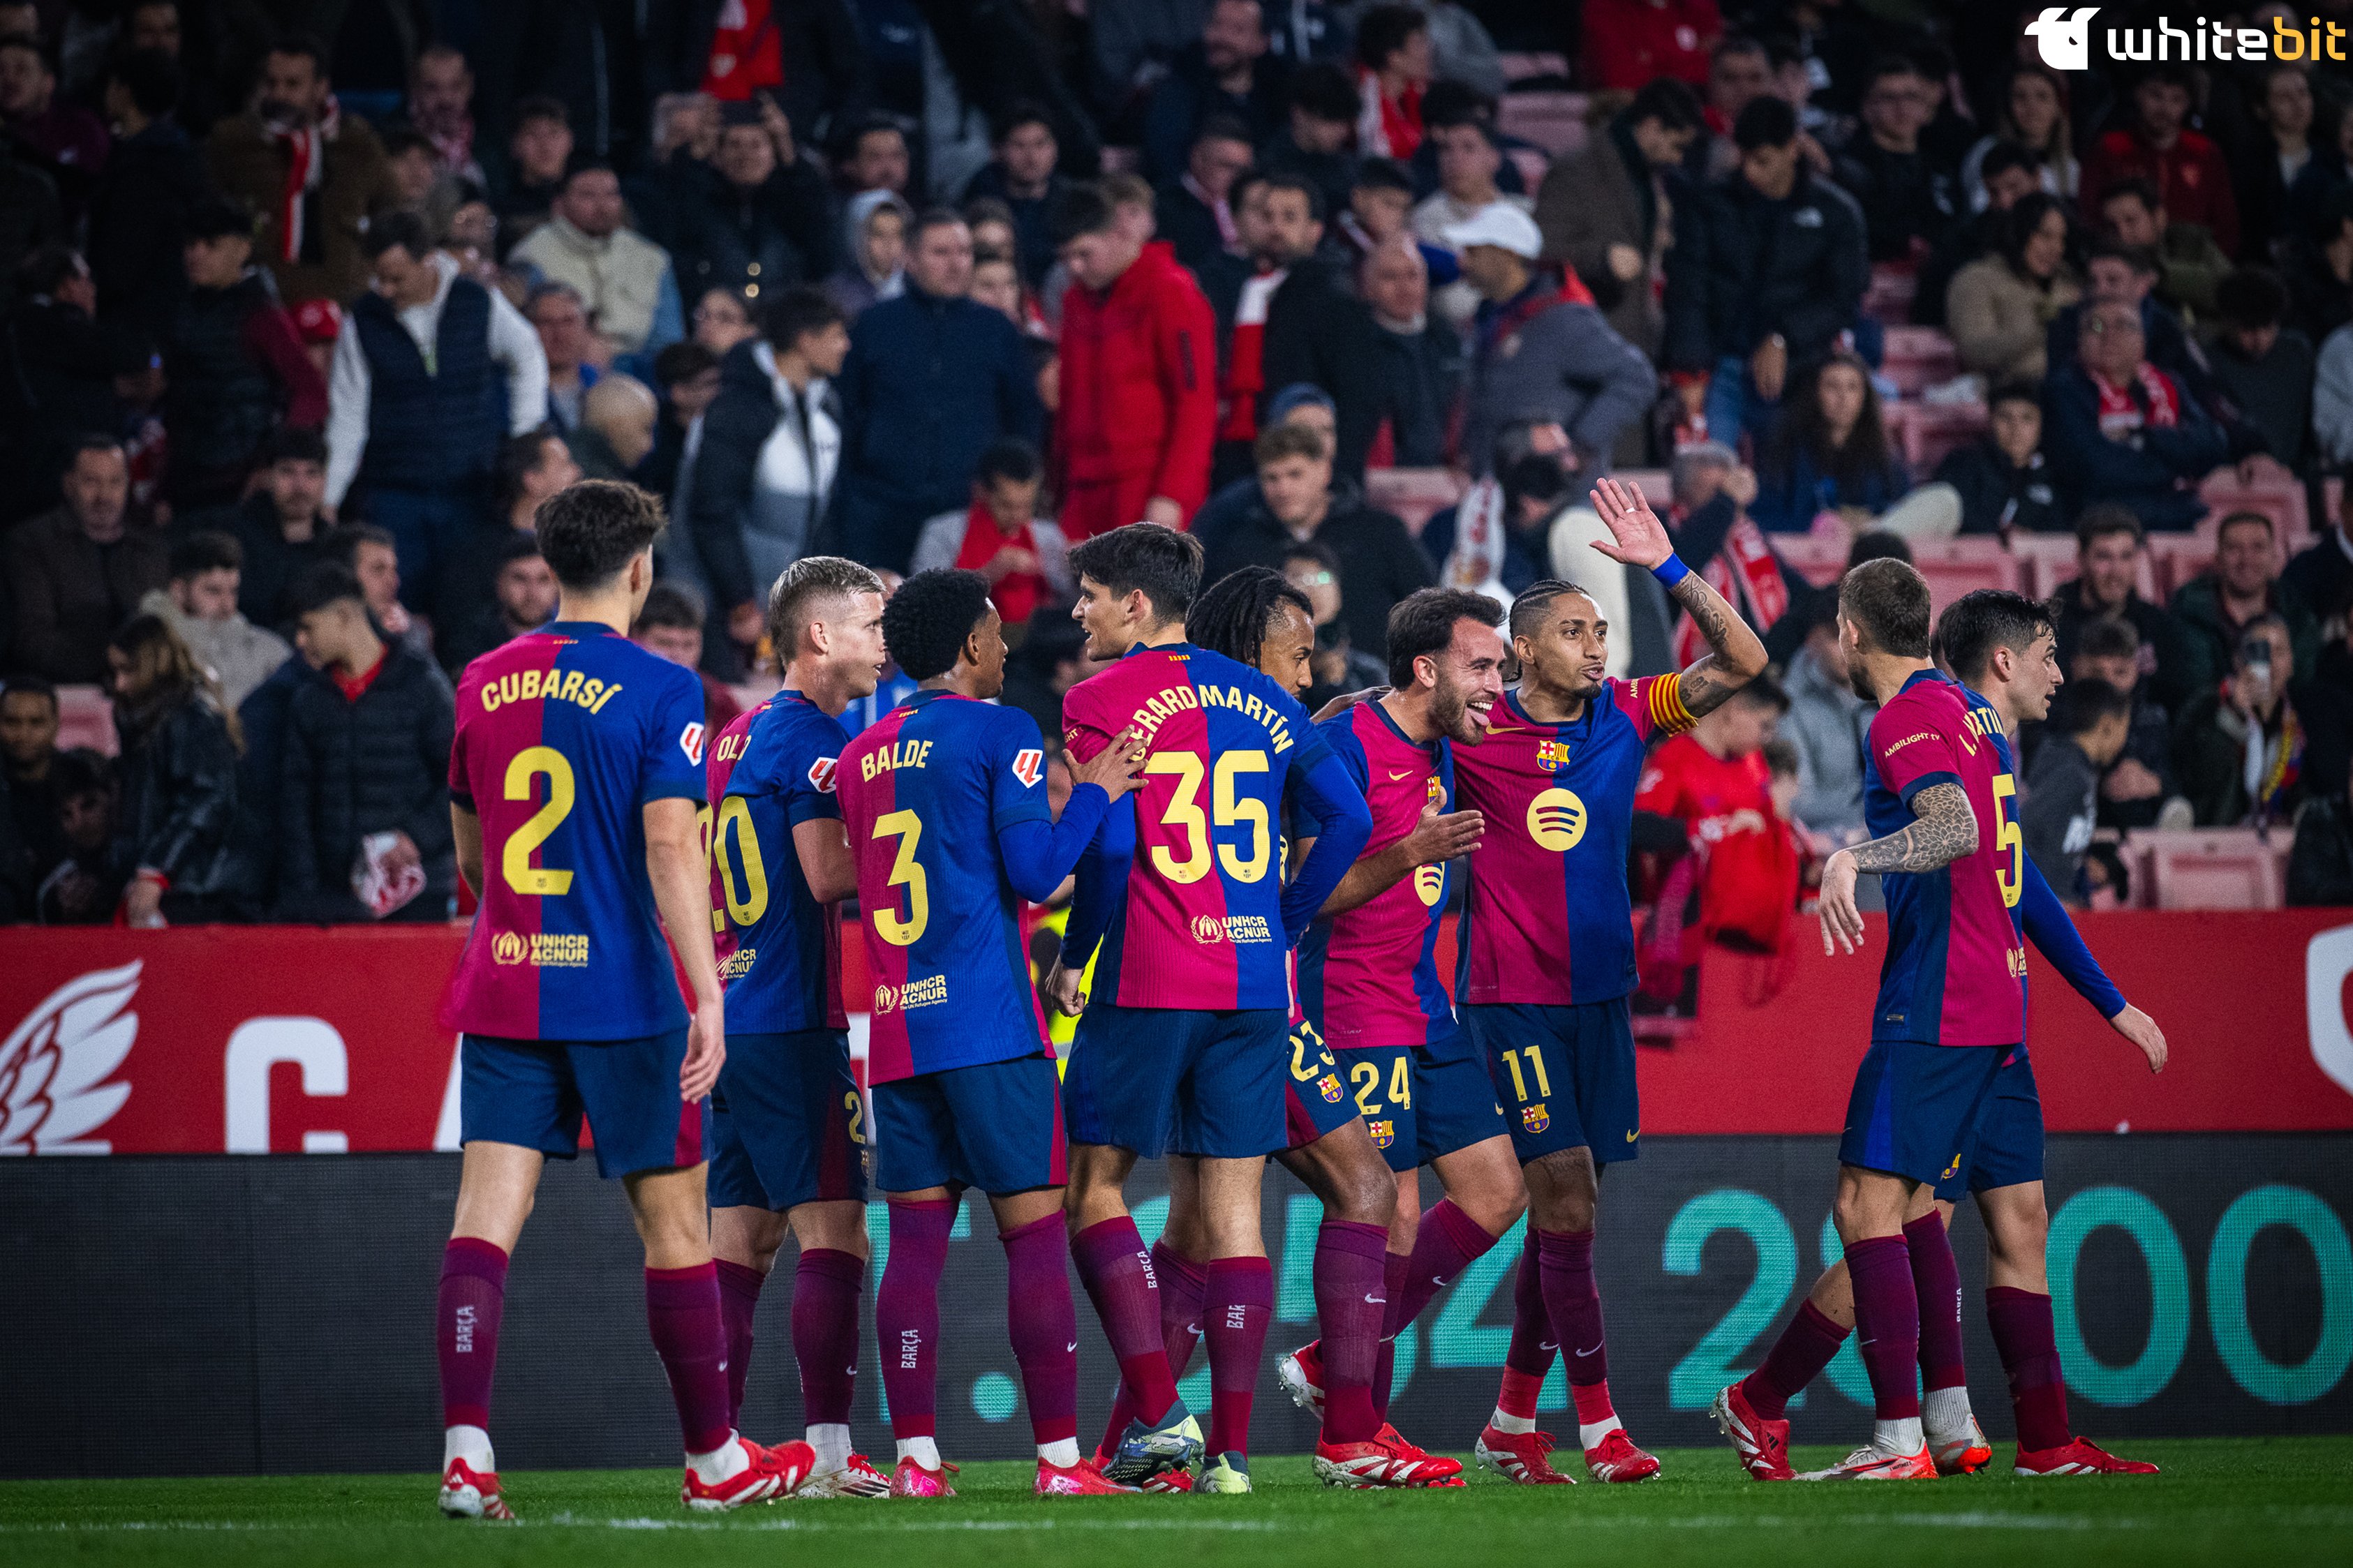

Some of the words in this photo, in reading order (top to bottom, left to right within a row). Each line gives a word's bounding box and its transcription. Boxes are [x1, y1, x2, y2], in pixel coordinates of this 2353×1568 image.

[481, 669, 622, 715] CUBARSÍ
[1198, 685, 1293, 754] MARTÍN
[861, 739, 934, 782] BALDE
[1885, 732, 1929, 759] AMBILIGHT
[502, 746, 575, 895] 2
[1144, 750, 1270, 884] 35
[1992, 774, 2023, 908] 5
[872, 809, 928, 946] 3
[530, 933, 589, 948] UNHCR
[1222, 916, 1268, 929] UNHCR
[1226, 927, 1271, 939] ACNUR
[530, 948, 588, 962] ACNUR
[899, 986, 947, 1006] ACNUR
[900, 974, 947, 995] UNHCR
[1351, 1056, 1411, 1115] 24
[1501, 1045, 1551, 1102] 11
[457, 1304, 478, 1352] BARÇA
[900, 1329, 921, 1369] BARÇA
